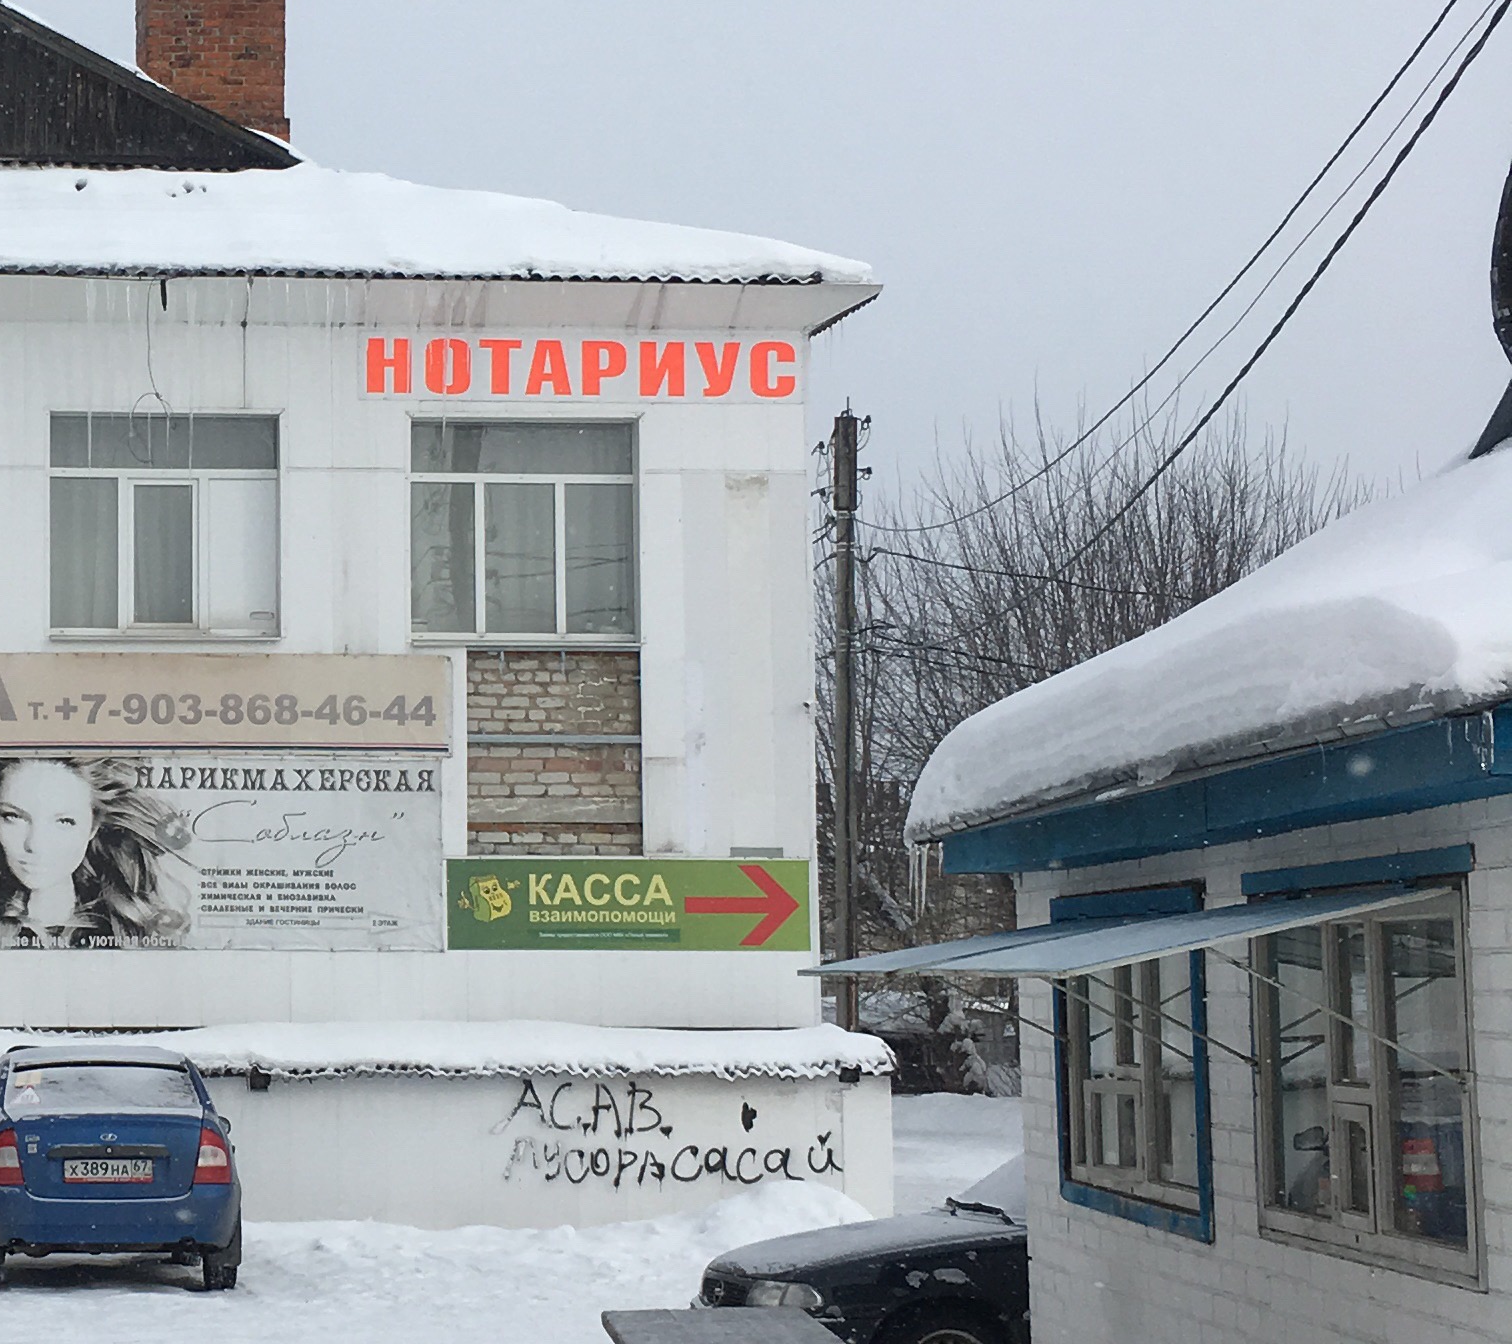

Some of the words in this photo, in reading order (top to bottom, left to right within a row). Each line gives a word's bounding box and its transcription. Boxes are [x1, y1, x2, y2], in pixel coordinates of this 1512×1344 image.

[365, 337, 797, 399] НОТАРИУС
[28, 698, 49, 722] т.
[54, 692, 437, 727] +7-903-868-46-44
[134, 765, 435, 793] ПАРИКМАХЕРСКАЯ
[200, 868, 242, 878] СТРИЖКИ
[292, 868, 334, 878] МУЖСКИЕ
[222, 881, 249, 890] ВИДЫ
[252, 881, 320, 891] ОКРАШИВАНИЯ
[324, 881, 357, 891] ВОЛОС
[528, 872, 674, 907] КАССА
[200, 893, 262, 902] ХИМИЧЕСКАЯ
[266, 893, 273, 902] И
[277, 893, 337, 902] БИОЗАВИВКА
[200, 904, 254, 913] СВАДЕБНЫЕ
[258, 905, 266, 913] И
[269, 905, 313, 914] ВЕЧЕРНИЕ
[317, 905, 364, 914] ПРИЧЕСКИ
[529, 909, 676, 926] взаимопомощи
